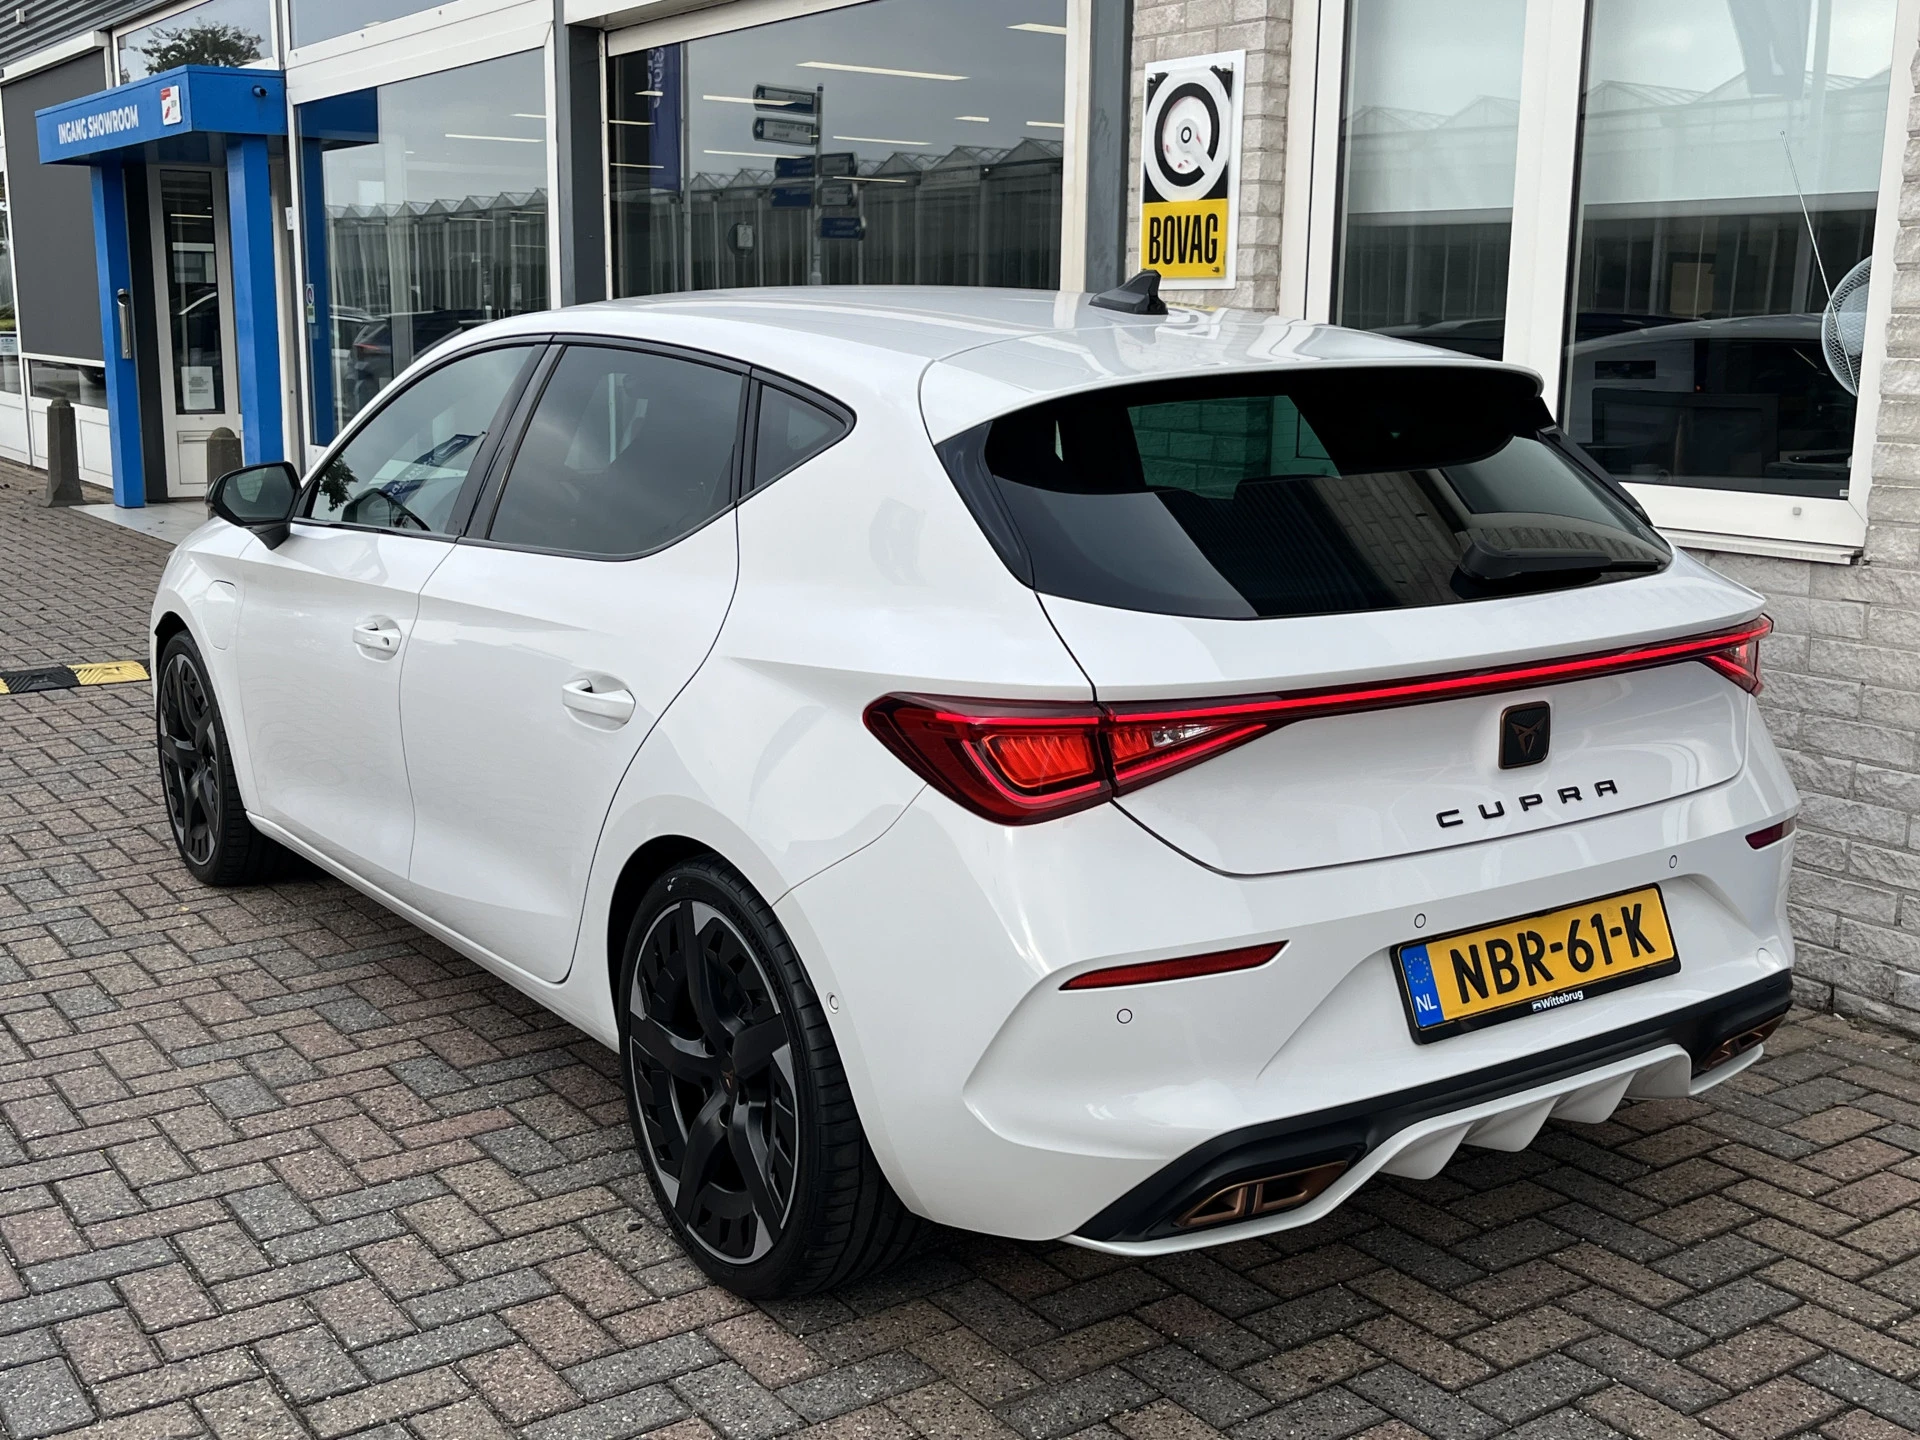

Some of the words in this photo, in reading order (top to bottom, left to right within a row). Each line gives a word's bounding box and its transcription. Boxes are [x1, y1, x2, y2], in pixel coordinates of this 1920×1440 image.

[58, 117, 88, 145] INGANG
[87, 104, 139, 139] SHOWROOM
[1148, 212, 1219, 265] BOVAG
[1435, 779, 1620, 829] CUPRA
[1449, 903, 1656, 1005] NBR-61-K
[1414, 993, 1438, 1013] NL
[1540, 989, 1585, 1011] Wittebrug
